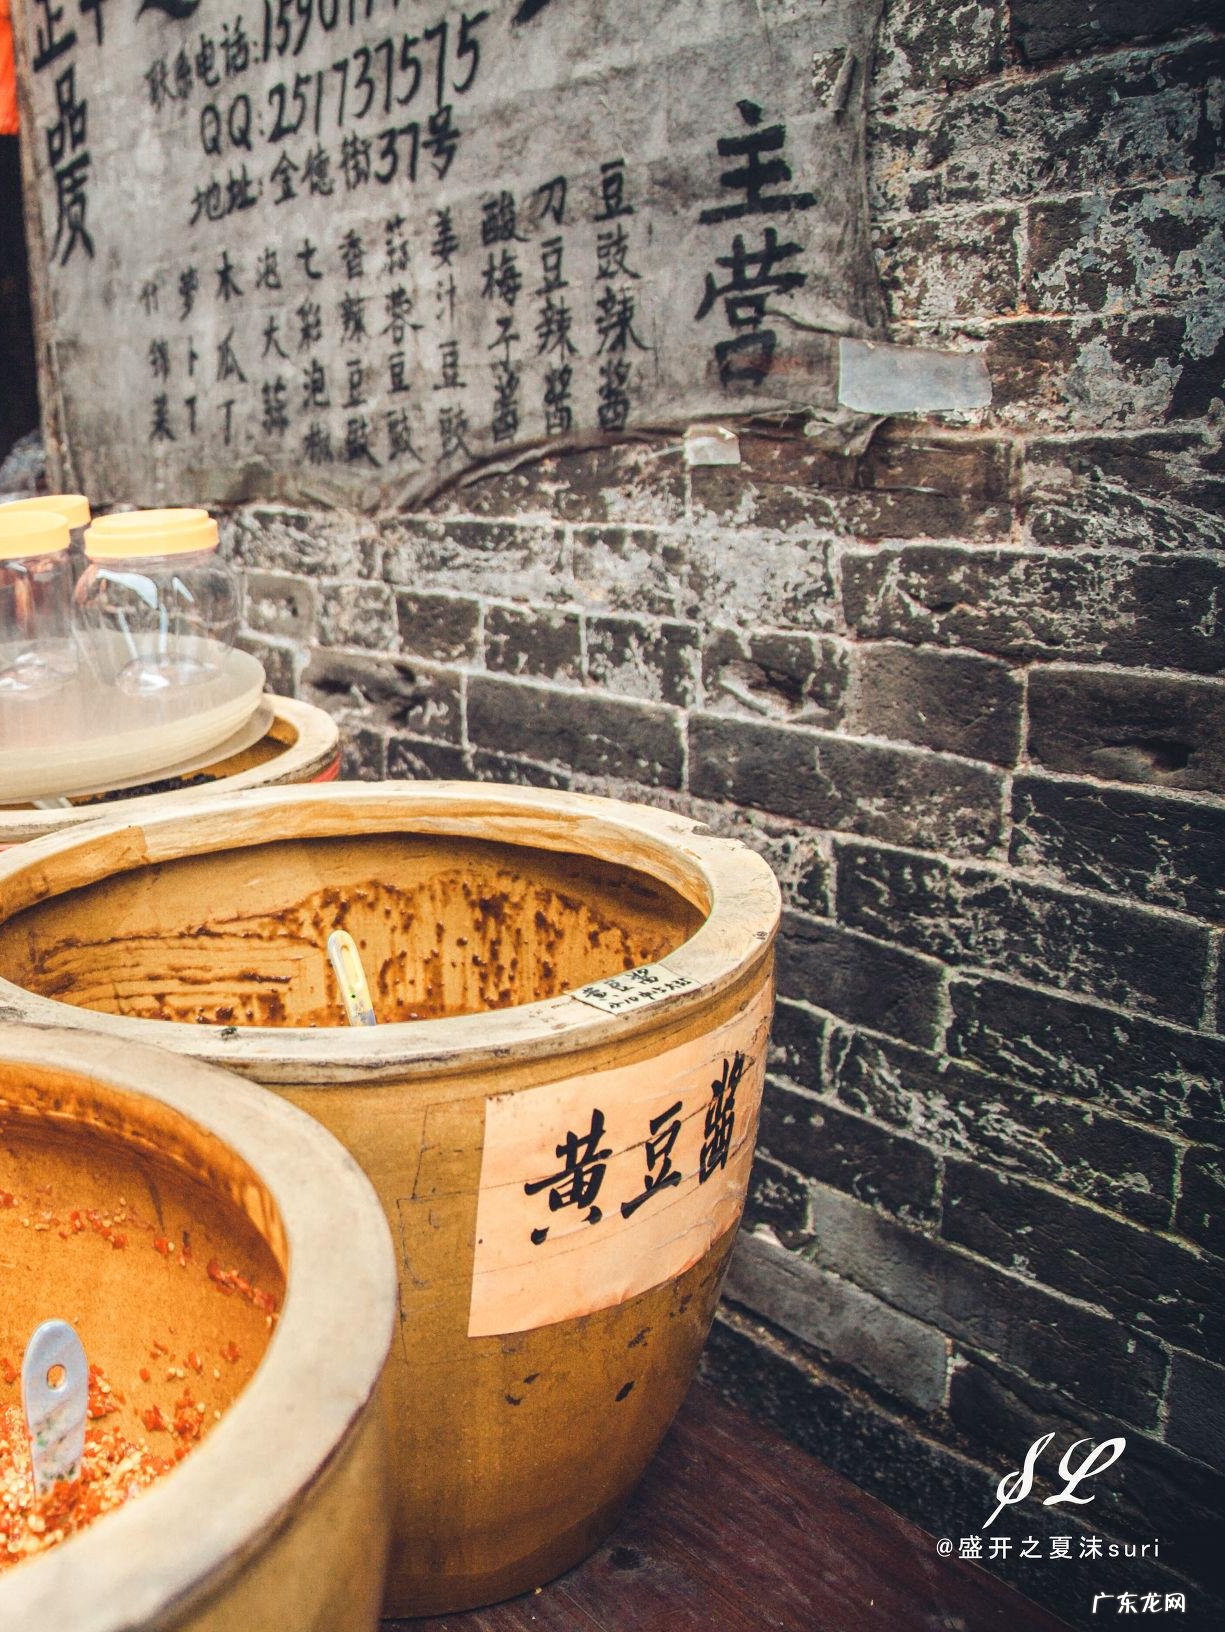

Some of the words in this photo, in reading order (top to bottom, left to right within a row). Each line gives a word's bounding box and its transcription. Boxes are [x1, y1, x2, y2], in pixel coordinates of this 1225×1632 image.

[215, 250, 248, 447] 木瓜丁
[694, 99, 818, 386] 主营
